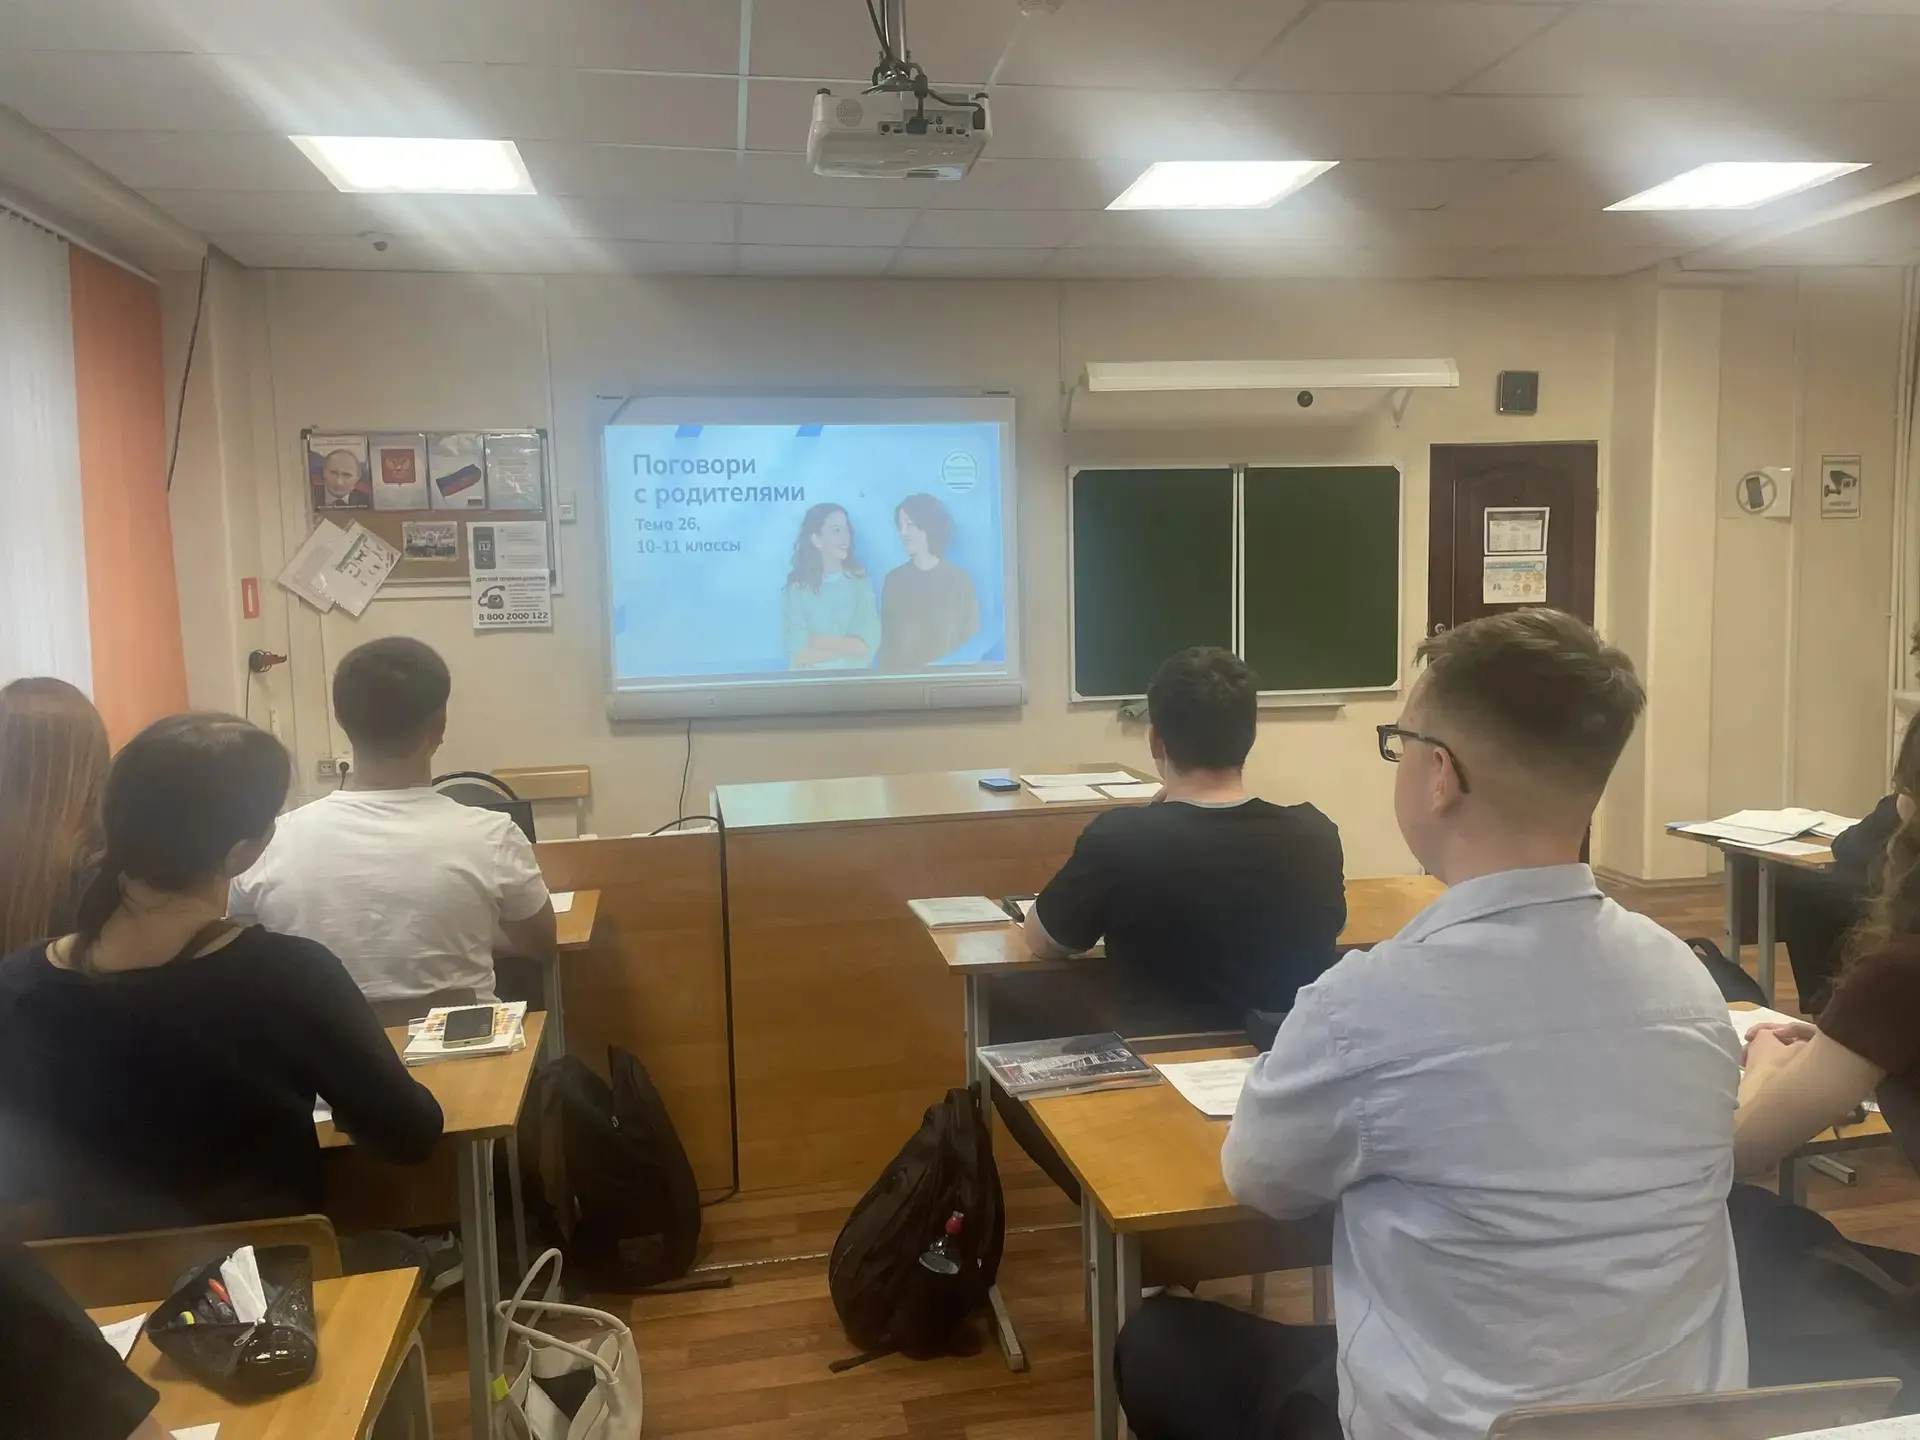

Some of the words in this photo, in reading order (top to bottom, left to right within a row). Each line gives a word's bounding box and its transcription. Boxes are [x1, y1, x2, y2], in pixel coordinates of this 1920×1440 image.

[633, 454, 756, 480] Поговори
[634, 488, 647, 503] с
[656, 485, 805, 509] родителями
[635, 517, 674, 531] Тема
[636, 539, 681, 554] 10-11
[685, 540, 741, 553] классы
[506, 612, 530, 620] 2000
